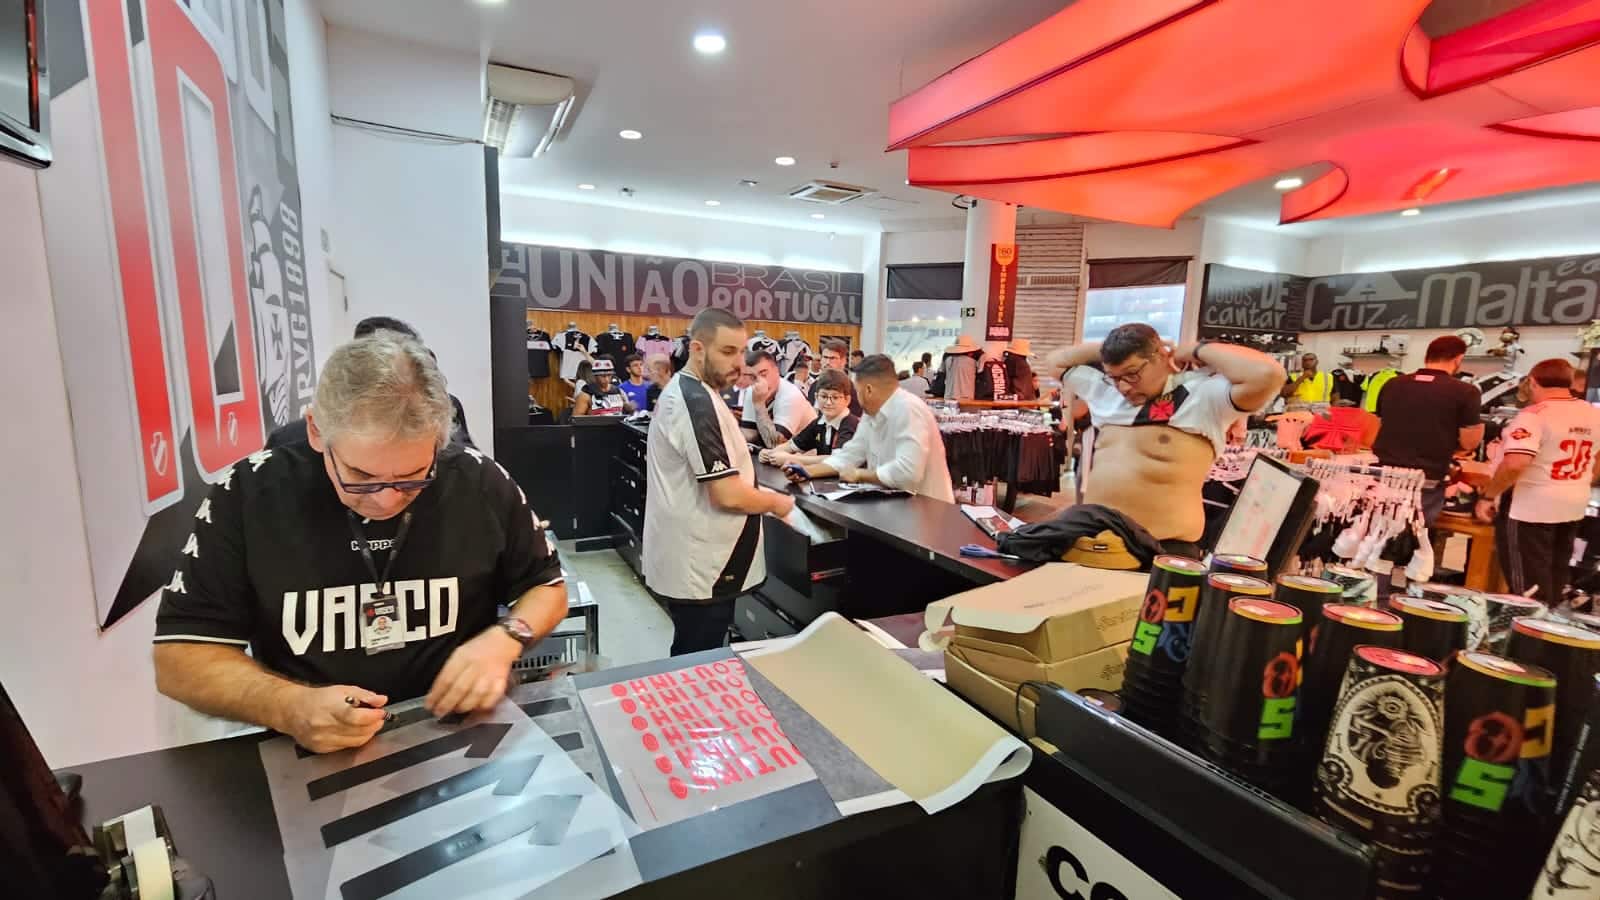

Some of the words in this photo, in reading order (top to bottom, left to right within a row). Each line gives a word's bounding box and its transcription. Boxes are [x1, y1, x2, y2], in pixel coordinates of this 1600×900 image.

[528, 246, 709, 316] UNIÃO
[711, 262, 863, 296] BRASIL
[711, 286, 861, 324] PORTUGAL
[1204, 302, 1288, 330] cantar
[1302, 276, 1388, 331] Cruz
[1416, 266, 1599, 328] Malta
